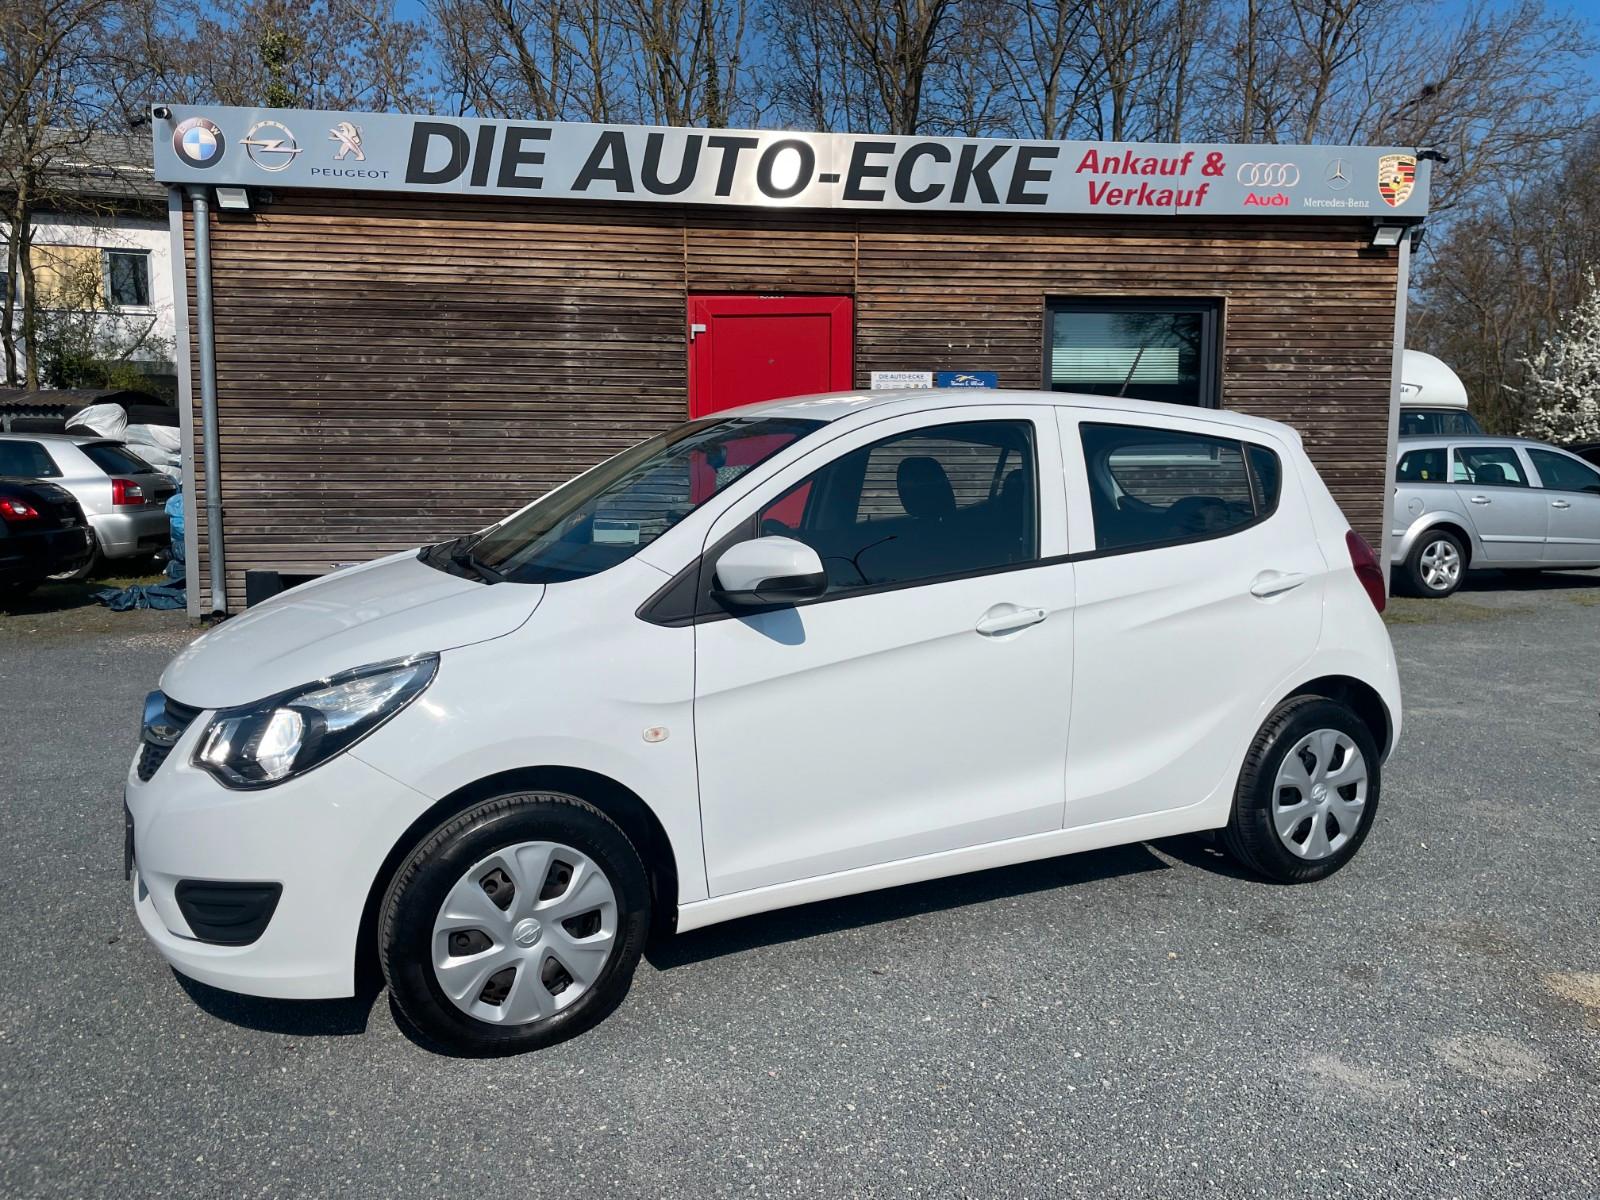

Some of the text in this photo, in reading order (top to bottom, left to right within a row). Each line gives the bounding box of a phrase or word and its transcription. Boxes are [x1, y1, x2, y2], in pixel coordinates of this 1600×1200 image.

[405, 121, 1060, 206] DIE AUTO-ECKE
[1075, 149, 1226, 177] Ankauf &
[311, 168, 389, 180] PEUGEOT
[1088, 181, 1210, 206] Verkauf
[1243, 192, 1290, 207] Audi
[1303, 197, 1370, 209] Mercedes-Benz
